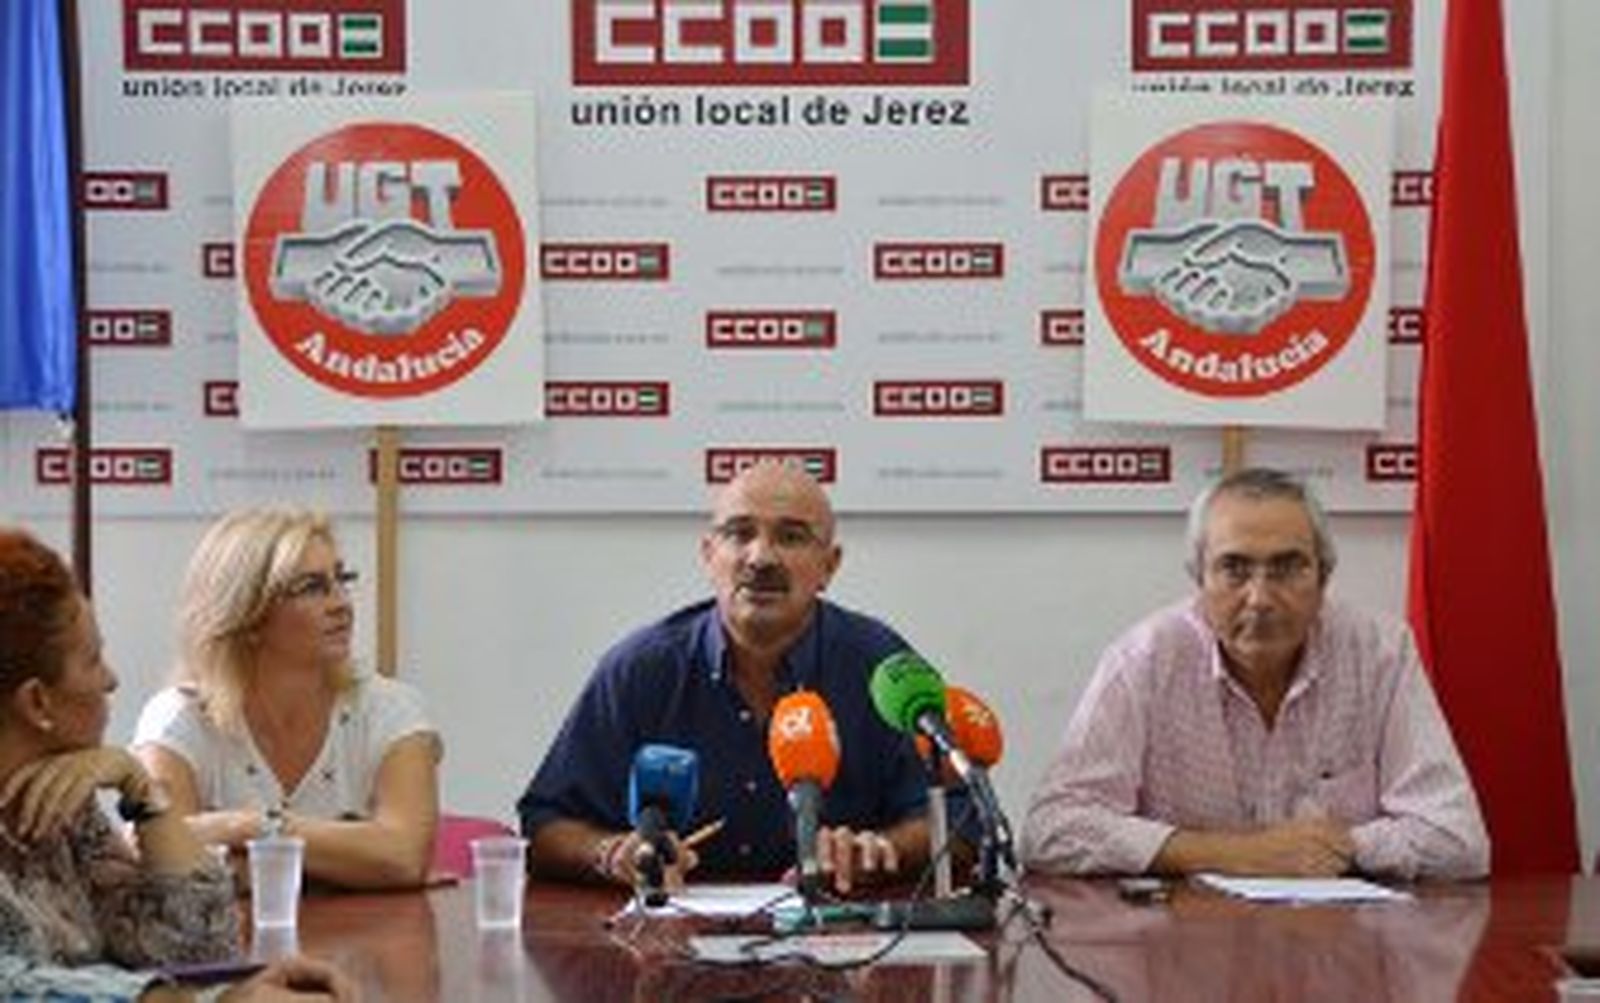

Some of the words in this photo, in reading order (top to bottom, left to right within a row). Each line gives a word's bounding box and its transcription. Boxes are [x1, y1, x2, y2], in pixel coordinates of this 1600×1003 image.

[138, 10, 331, 57] CCOO
[595, 0, 865, 63] CCOO
[1147, 11, 1338, 56] CCOO
[570, 94, 681, 125] unión
[695, 94, 789, 125] local
[801, 95, 850, 125] de
[862, 95, 970, 126] Jerez
[303, 161, 463, 230] UGT
[712, 182, 804, 205] CCOO
[1154, 157, 1316, 229] UGT
[545, 251, 637, 274] CCOO
[881, 250, 970, 273] CCOO
[712, 319, 804, 341] CCOO
[545, 387, 637, 411] CCOO
[881, 388, 970, 410] CCOO
[1048, 454, 1138, 477] CCOO
